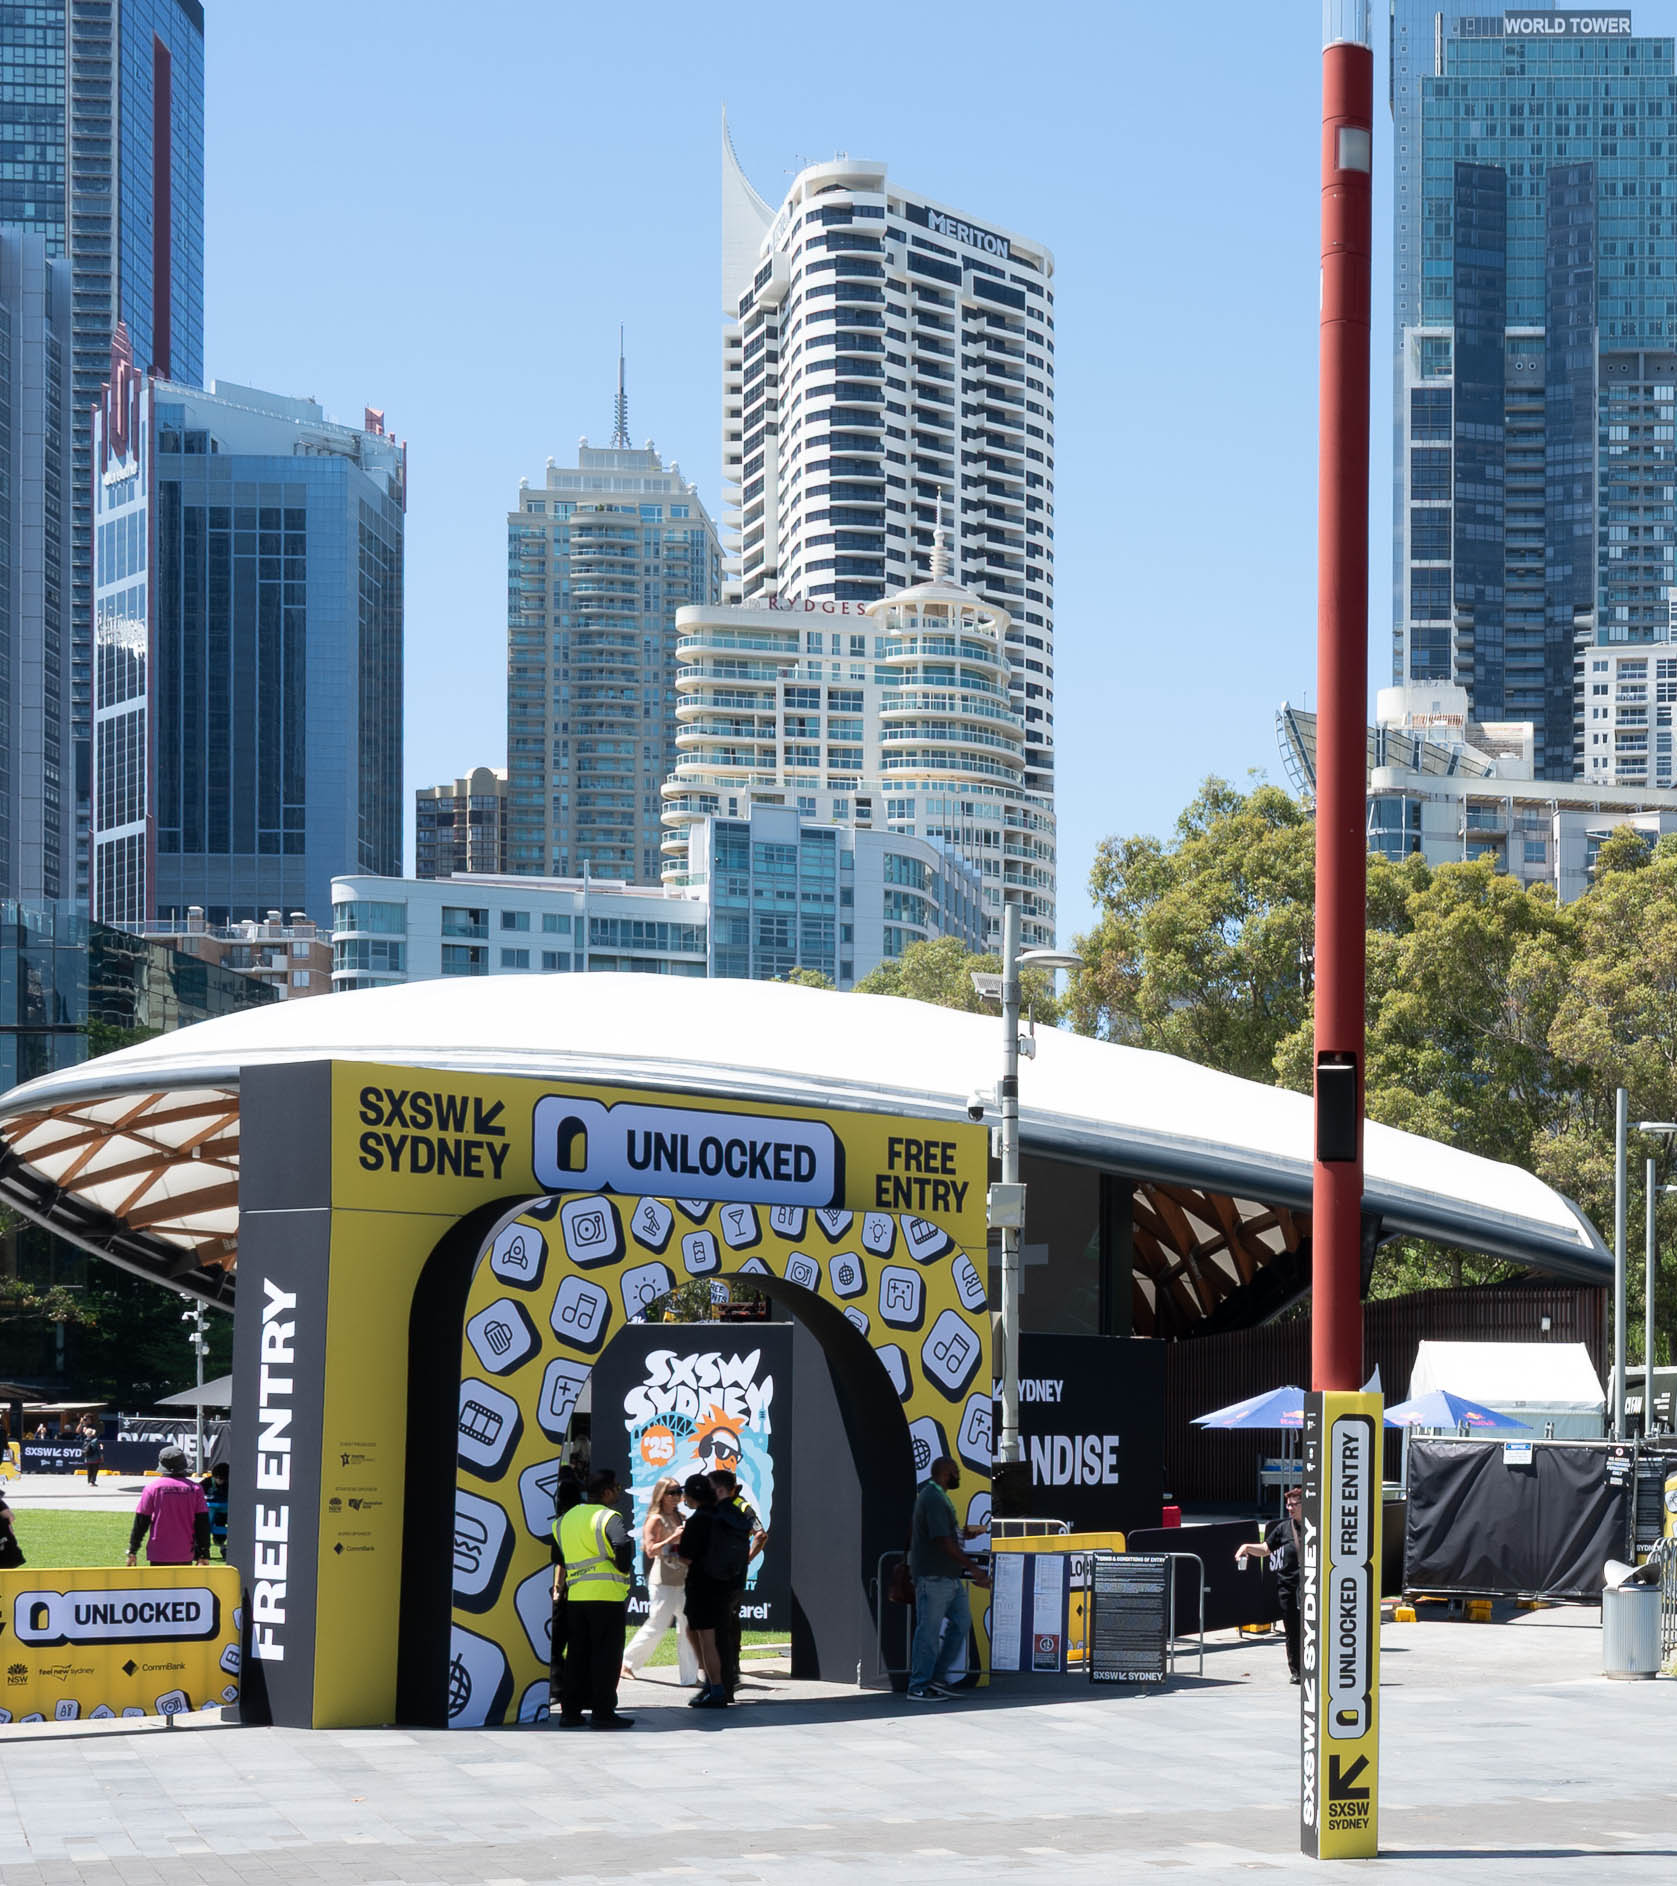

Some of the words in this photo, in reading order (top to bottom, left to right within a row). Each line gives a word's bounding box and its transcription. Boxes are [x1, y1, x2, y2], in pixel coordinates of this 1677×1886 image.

[1504, 18, 1566, 33] WORLD
[1569, 18, 1631, 33] TOWER
[928, 209, 1008, 259] MERITON
[768, 598, 865, 615] RYDGES
[359, 1086, 469, 1133] SXSW
[359, 1131, 511, 1179] SYDNEY
[626, 1129, 817, 1183] UNLOCKED
[887, 1136, 957, 1175] FREE
[875, 1174, 969, 1214] ENTRY
[256, 1276, 297, 1491] ENTRY
[643, 1349, 761, 1390] SXSW
[1018, 1379, 1064, 1402] YDNEY
[624, 1375, 774, 1434] SYDNEY
[25, 1447, 52, 1457] SXSW
[62, 1447, 83, 1458] SYD
[1342, 1432, 1359, 1501] ENTRY
[1341, 1505, 1358, 1556] FREE
[251, 1503, 290, 1662] FREE
[1304, 1516, 1317, 1671] SYDNEY
[74, 1601, 201, 1626] UNLOCKED
[1339, 1577, 1357, 1689] UNLOCKED
[7, 1676, 28, 1685] NSW
[39, 1667, 53, 1676] feel
[53, 1665, 70, 1676] new
[70, 1666, 95, 1677] sydney
[142, 1660, 186, 1673] CommBank
[1093, 1672, 1119, 1680] SXSW
[1128, 1672, 1163, 1681] SYDNEY
[1303, 1716, 1316, 1827] SXSW
[1328, 1803, 1370, 1817] SXSW
[1328, 1818, 1370, 1831] SYDNEY
